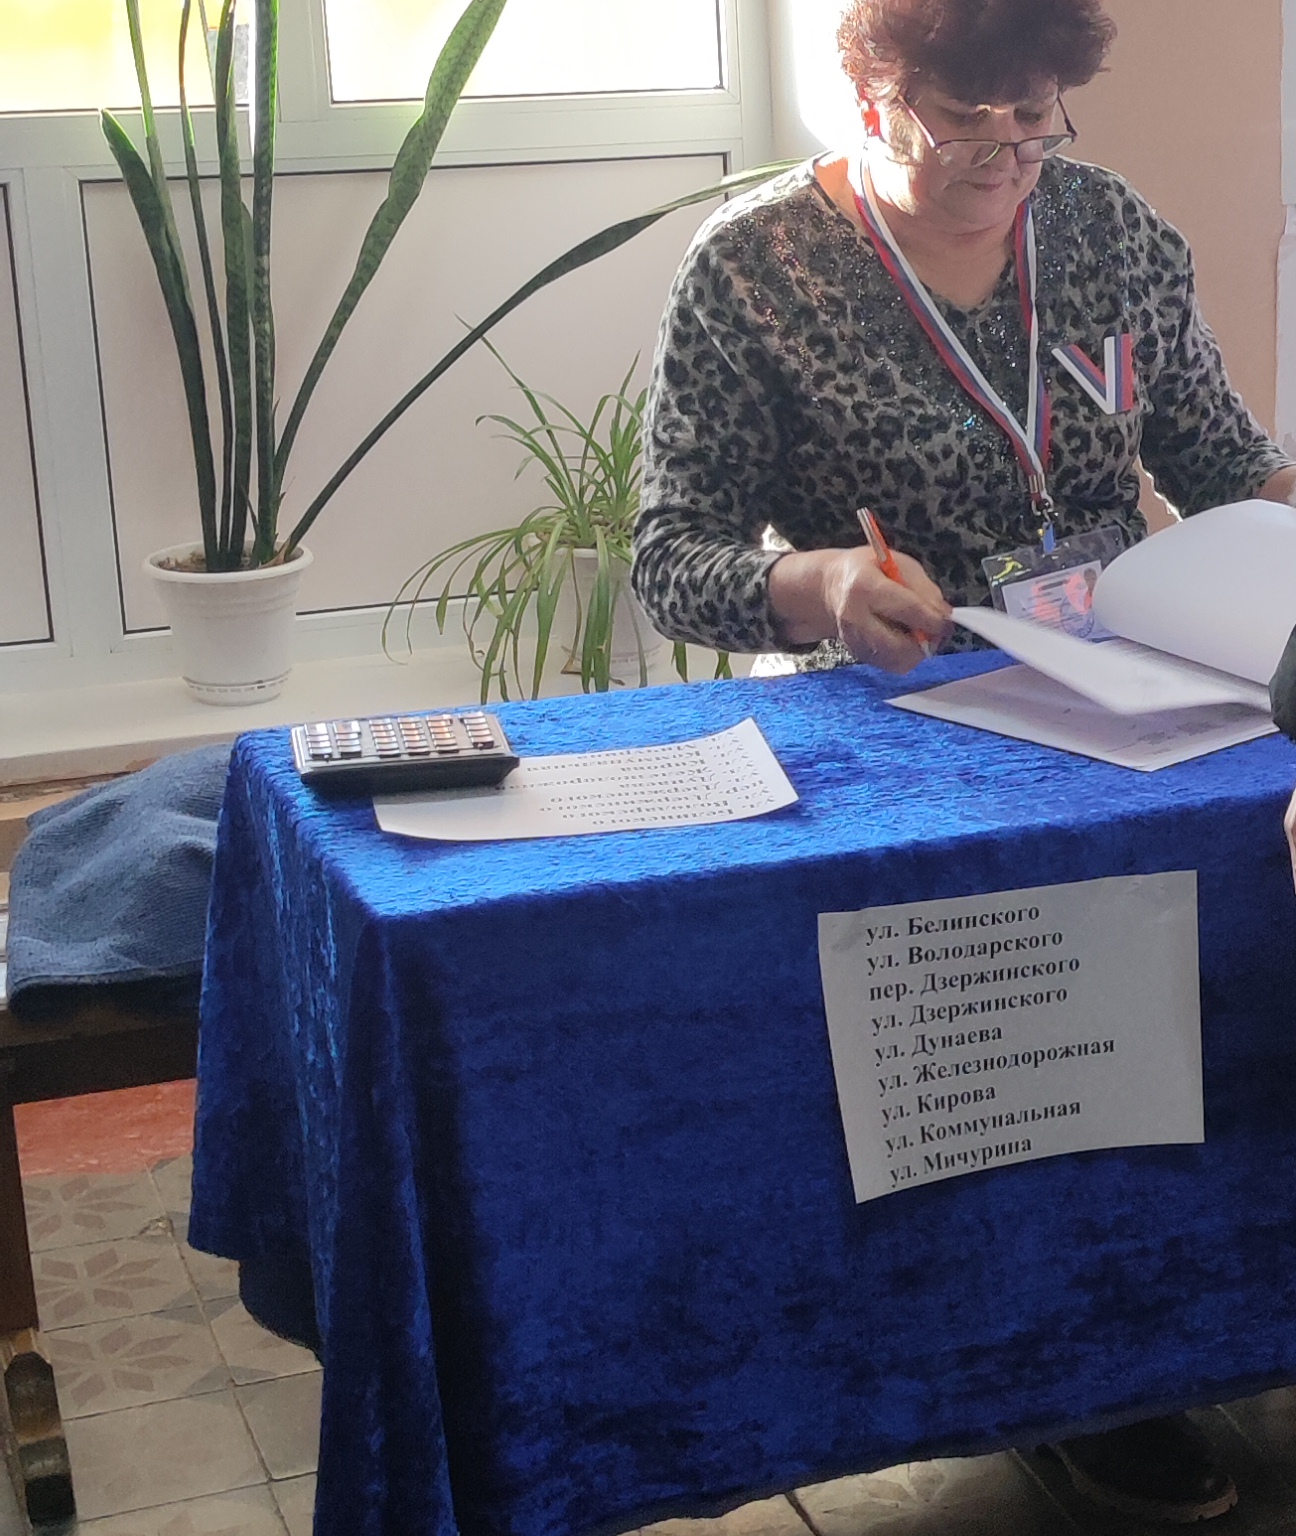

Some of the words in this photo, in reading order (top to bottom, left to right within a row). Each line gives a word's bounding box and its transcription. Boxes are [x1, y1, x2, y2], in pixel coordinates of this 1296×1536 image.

[866, 925, 899, 945] ул.
[908, 906, 1040, 937] Белинского
[867, 955, 900, 975] ул.
[908, 930, 1064, 964] Володарского
[869, 984, 914, 1002] пер.
[920, 957, 1081, 996] Дзержинского
[871, 1015, 903, 1035] ул.
[909, 987, 1068, 1027] Дзержинского
[874, 1045, 906, 1066] ул.
[911, 1027, 1003, 1056] Дунаева
[878, 1075, 908, 1097] ул.
[913, 1039, 1115, 1085] Железнодорожная
[881, 1106, 911, 1127] ул.
[917, 1086, 996, 1115] Кирова
[885, 1136, 914, 1158] ул.
[920, 1101, 1082, 1145] Коммунальная
[890, 1166, 918, 1188] ул.
[923, 1138, 1032, 1174] Мичурина
